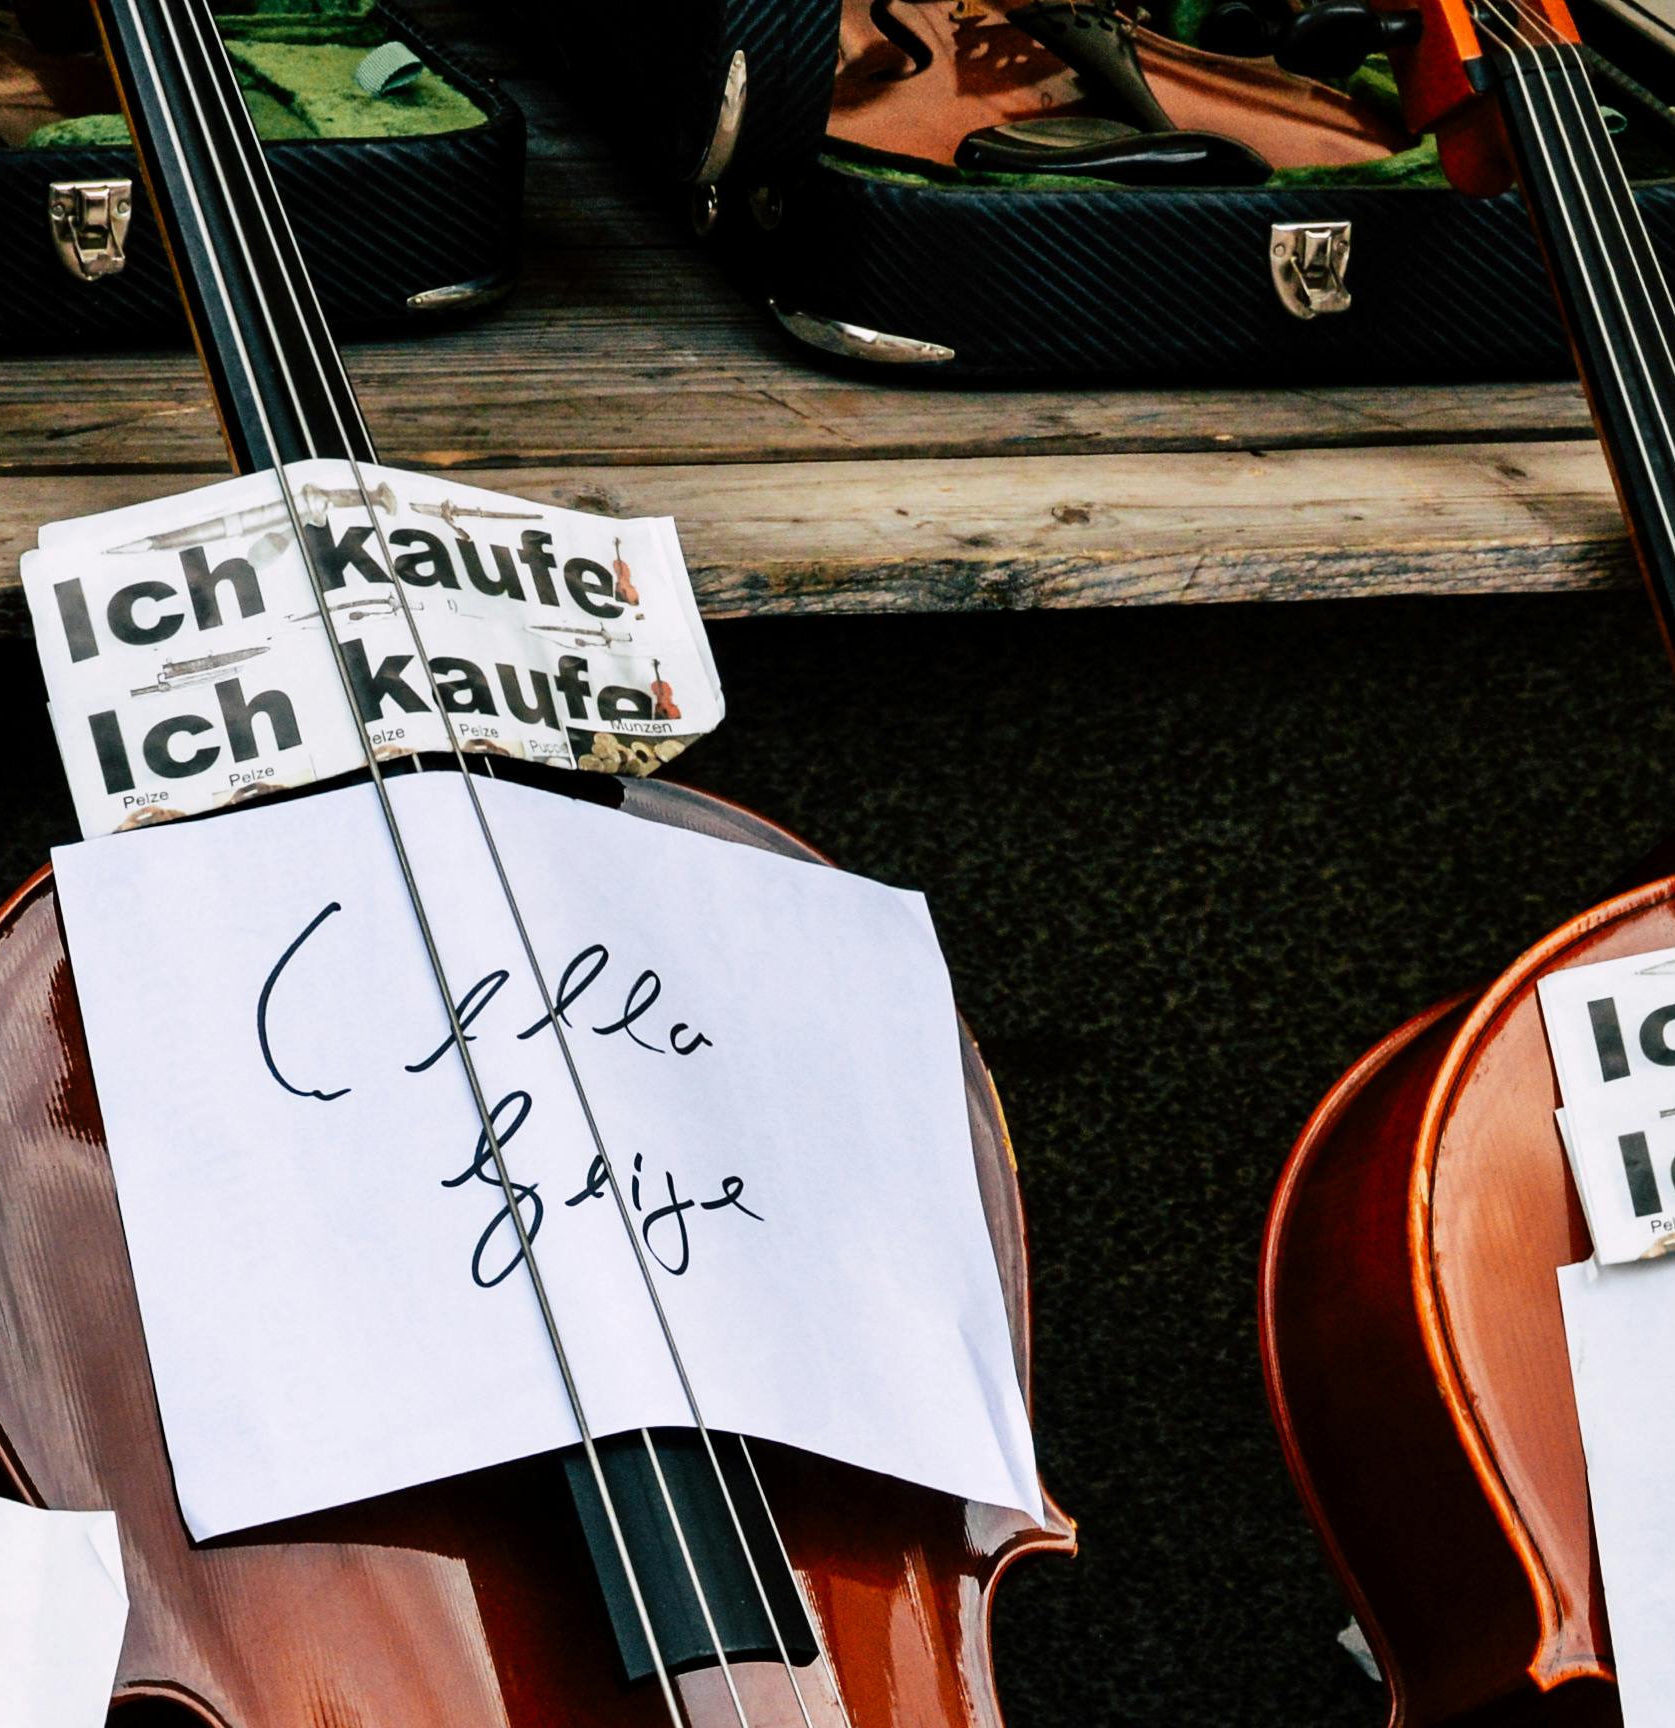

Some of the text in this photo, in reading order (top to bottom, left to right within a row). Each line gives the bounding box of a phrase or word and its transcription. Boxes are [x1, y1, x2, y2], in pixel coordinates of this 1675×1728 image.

[53, 523, 624, 664] Ich kaufe
[89, 637, 653, 795] Ich kaufe
[123, 723, 499, 808] Pelze Pelze elze Pelze
